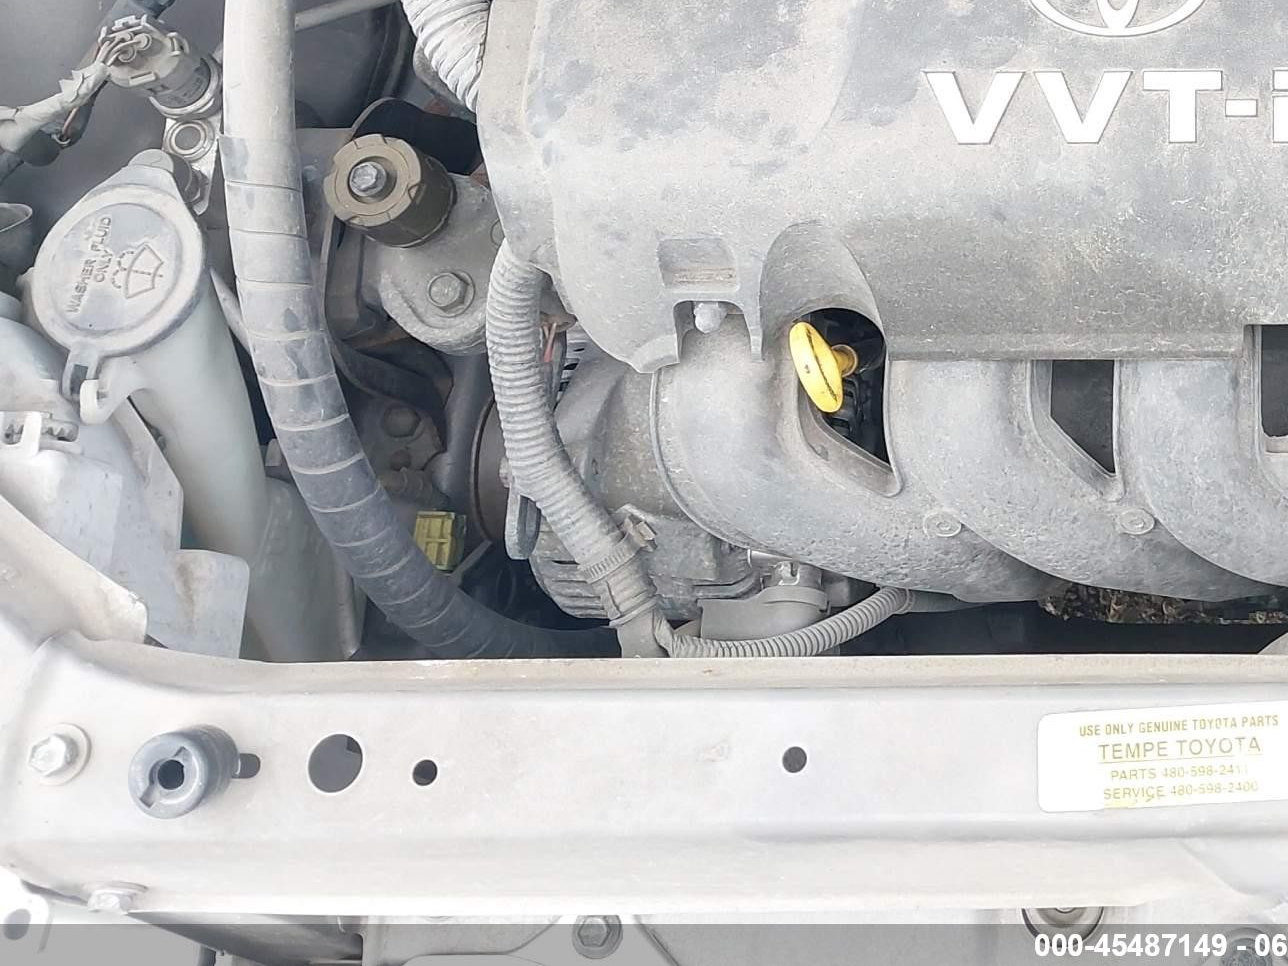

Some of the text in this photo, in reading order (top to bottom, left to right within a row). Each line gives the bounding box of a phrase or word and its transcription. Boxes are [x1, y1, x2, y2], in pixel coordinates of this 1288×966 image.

[66, 217, 112, 313] WASHER FLUID
[94, 249, 112, 283] ONLY
[1079, 714, 1279, 737] USE ONLY GENUINE TOYOTA PARTS
[1098, 736, 1262, 761] TEMPE TOYOTA
[1111, 768, 1157, 781] PARTS
[1104, 785, 1166, 801] SERVICE
